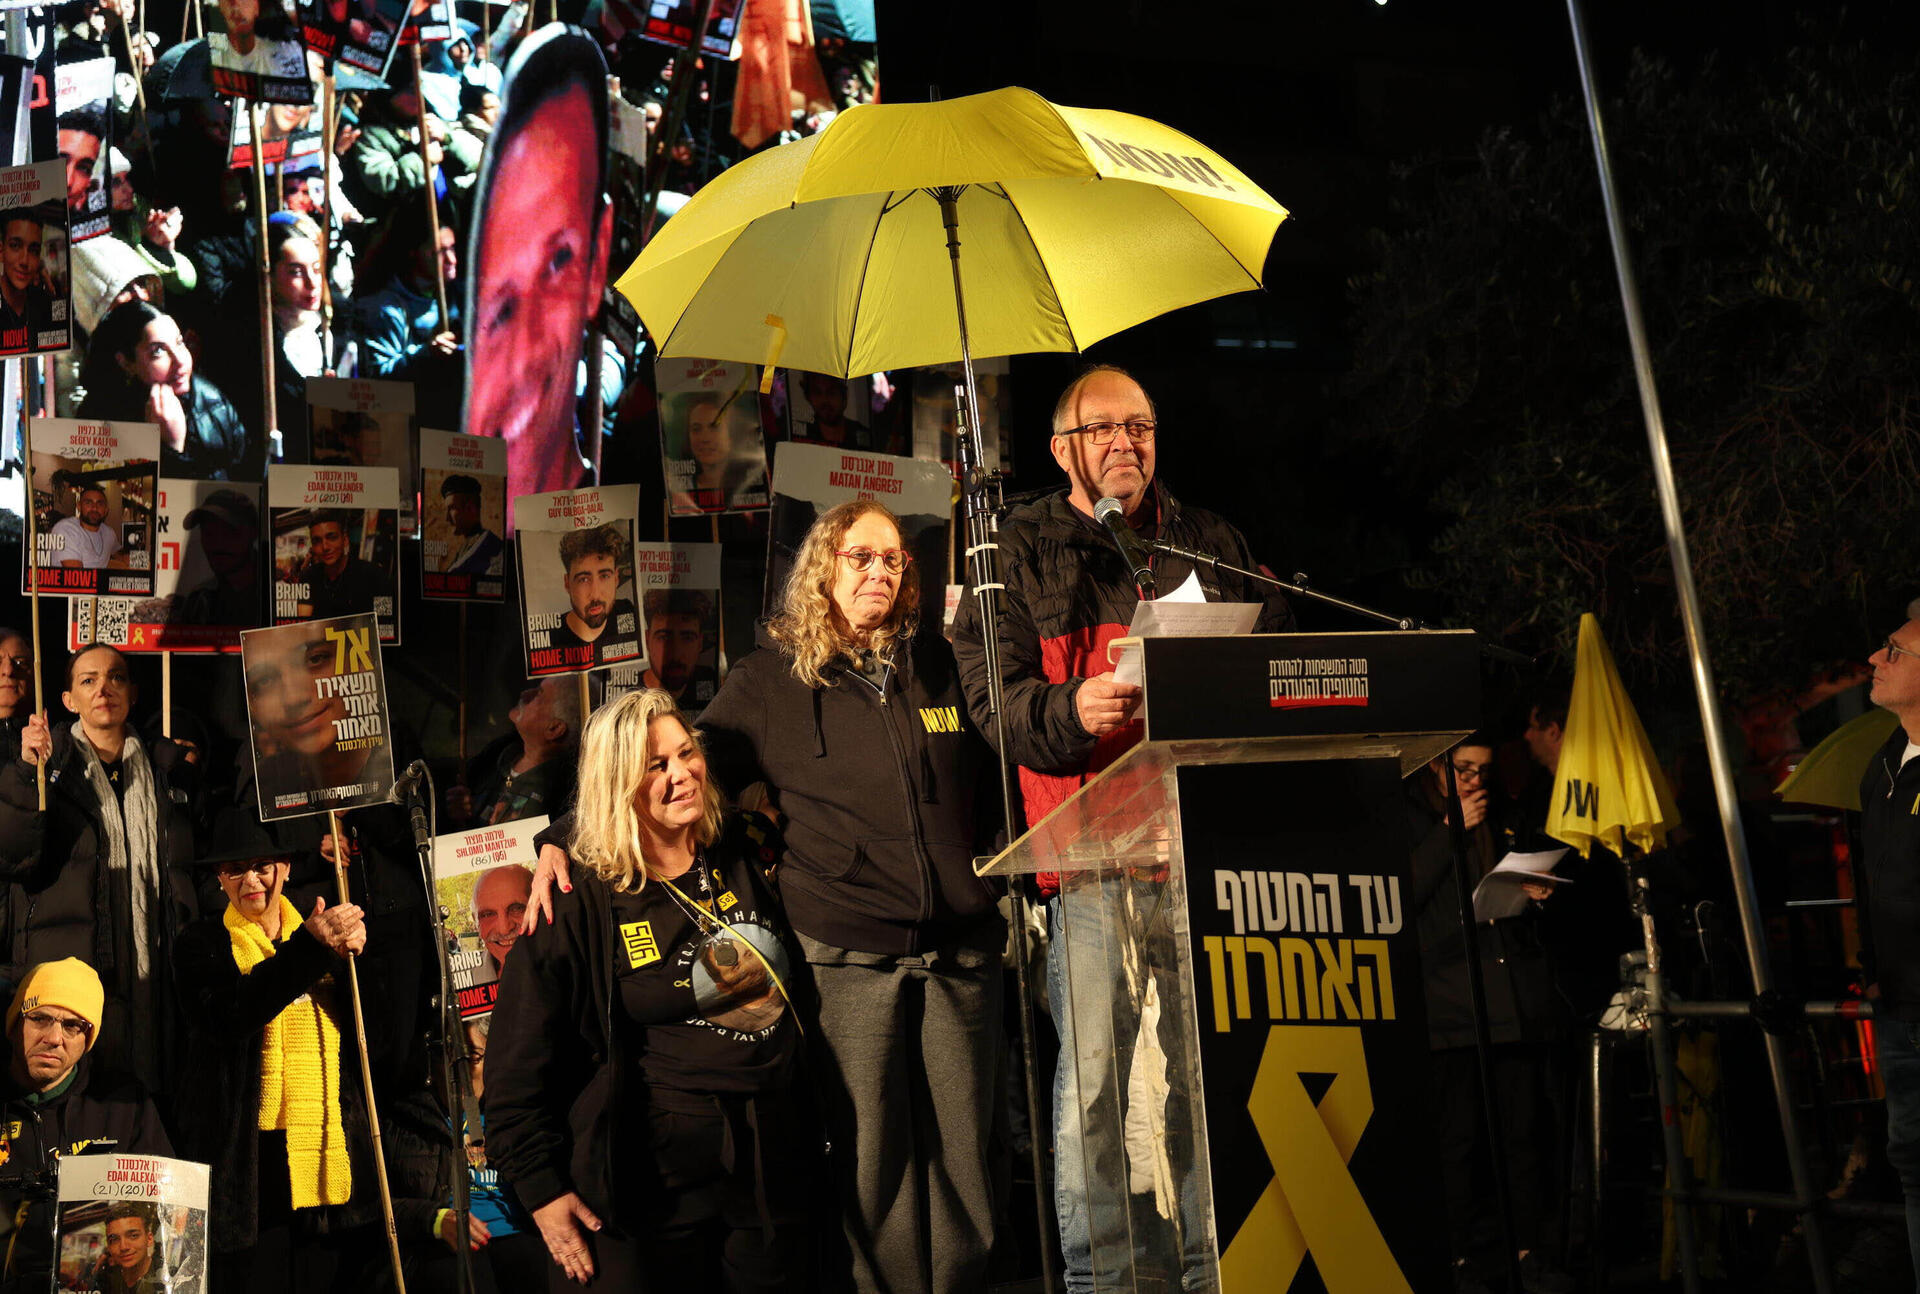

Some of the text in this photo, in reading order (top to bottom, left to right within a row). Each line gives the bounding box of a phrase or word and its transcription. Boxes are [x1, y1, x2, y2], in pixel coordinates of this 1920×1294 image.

[1083, 130, 1236, 193] NOW!
[3, 325, 28, 347] NOW!
[69, 435, 118, 448] SEGEV KALFON
[878, 460, 894, 476] מתן
[307, 482, 364, 493] EDAN ALEXANDER
[830, 472, 903, 494] MATAN ANGREST
[548, 502, 605, 518] GUY GILBOA-DALAL
[63, 569, 97, 587] NOW!
[648, 574, 667, 584] (23)
[275, 581, 311, 600] BRING
[276, 600, 298, 617] HIM
[528, 612, 561, 631] BRING
[529, 631, 551, 649] HIM
[325, 627, 374, 675] אל
[530, 649, 562, 668] HOME
[564, 642, 595, 663] NOW!
[1269, 657, 1368, 676] מטה המשפחות להחזרת
[315, 671, 377, 700] תשאירו
[1270, 677, 1369, 700] החטופים והנעדרים
[343, 692, 380, 717] אותי
[332, 714, 382, 741] מאחור
[335, 736, 384, 753] עידן אלכסנדר
[484, 830, 505, 843] שלמה
[455, 837, 518, 858] SHLOMO MANTZUR
[471, 854, 492, 868] (86)
[1214, 869, 1403, 935] עד החטוף
[1203, 935, 1396, 1033] האחרון
[733, 1031, 756, 1042] TAL
[116, 1158, 149, 1170] אלכסנדר
[107, 1170, 129, 1182] EDAN
[92, 1181, 145, 1198] (21) (20)
